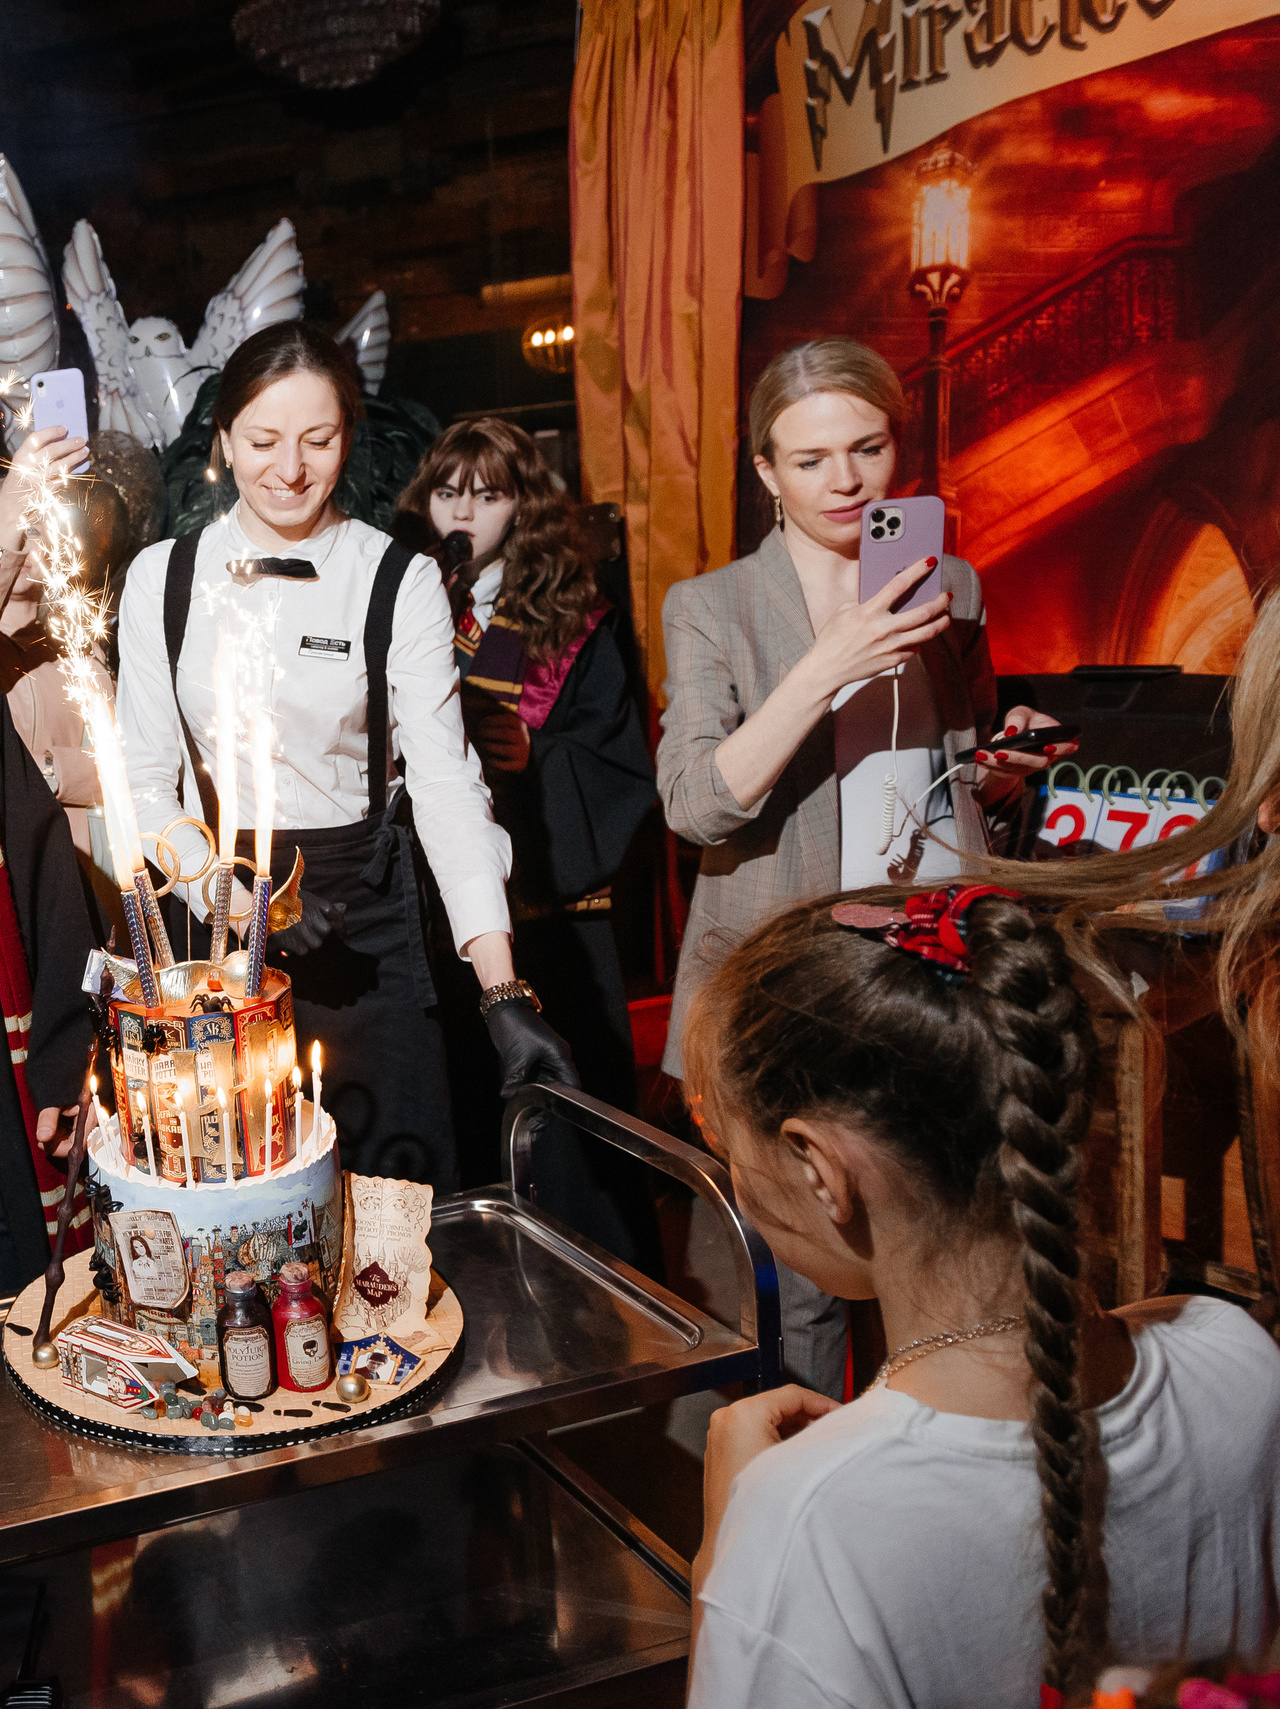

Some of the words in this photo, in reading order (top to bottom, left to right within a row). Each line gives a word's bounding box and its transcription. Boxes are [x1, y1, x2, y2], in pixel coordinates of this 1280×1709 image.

[803, 0, 1177, 172] Mirac
[154, 1059, 175, 1071] HARR
[155, 1068, 176, 1080] POTT
[356, 1279, 397, 1291] MARAUDER'S
[367, 1288, 383, 1298] MAP
[231, 1352, 264, 1362] POTION
